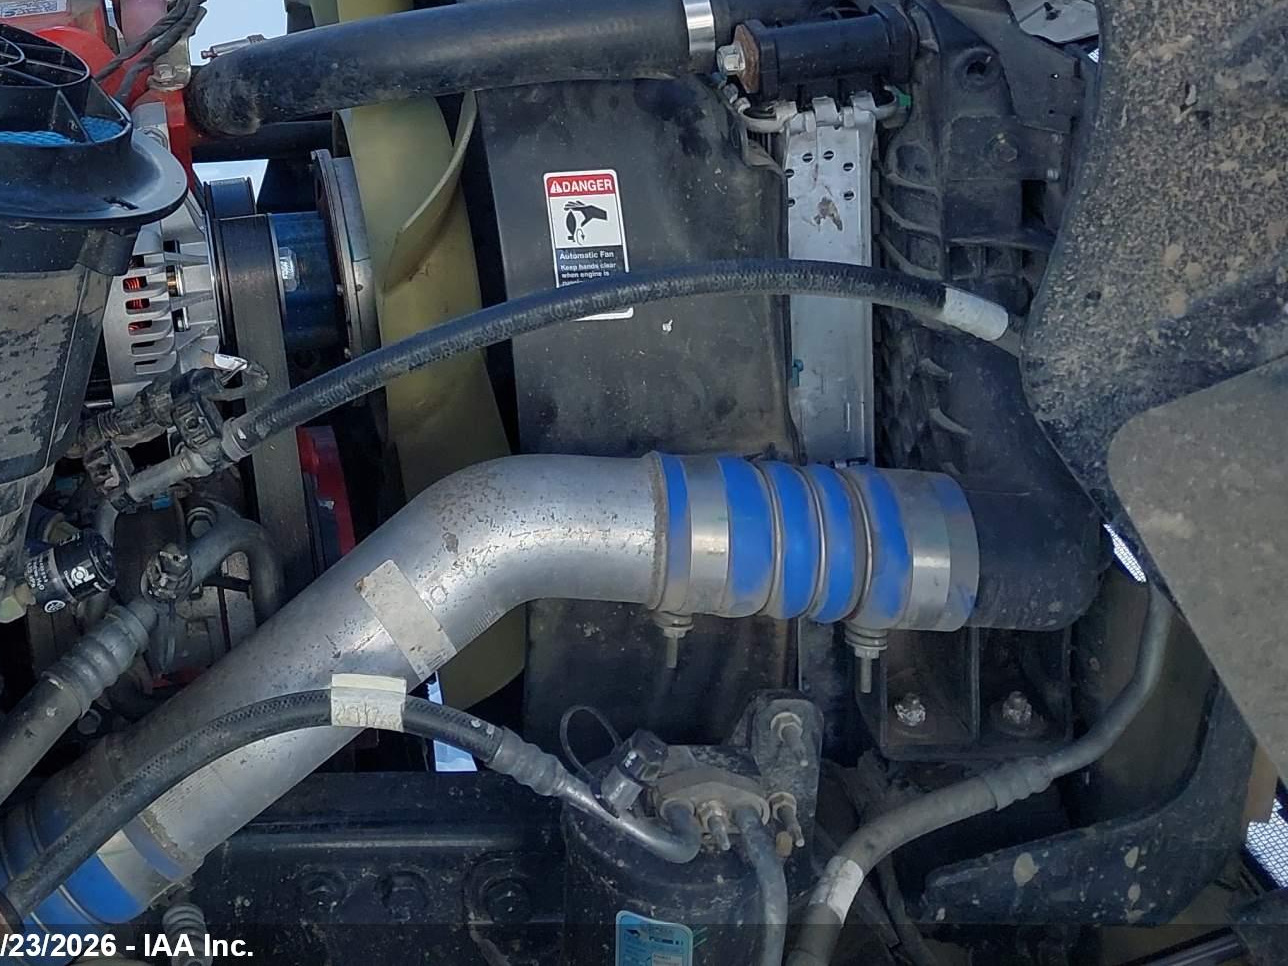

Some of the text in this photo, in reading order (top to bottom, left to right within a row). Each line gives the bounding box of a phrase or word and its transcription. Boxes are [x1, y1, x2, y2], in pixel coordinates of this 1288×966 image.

[562, 179, 612, 193] DANGER
[560, 250, 614, 260] Automatic Fan
